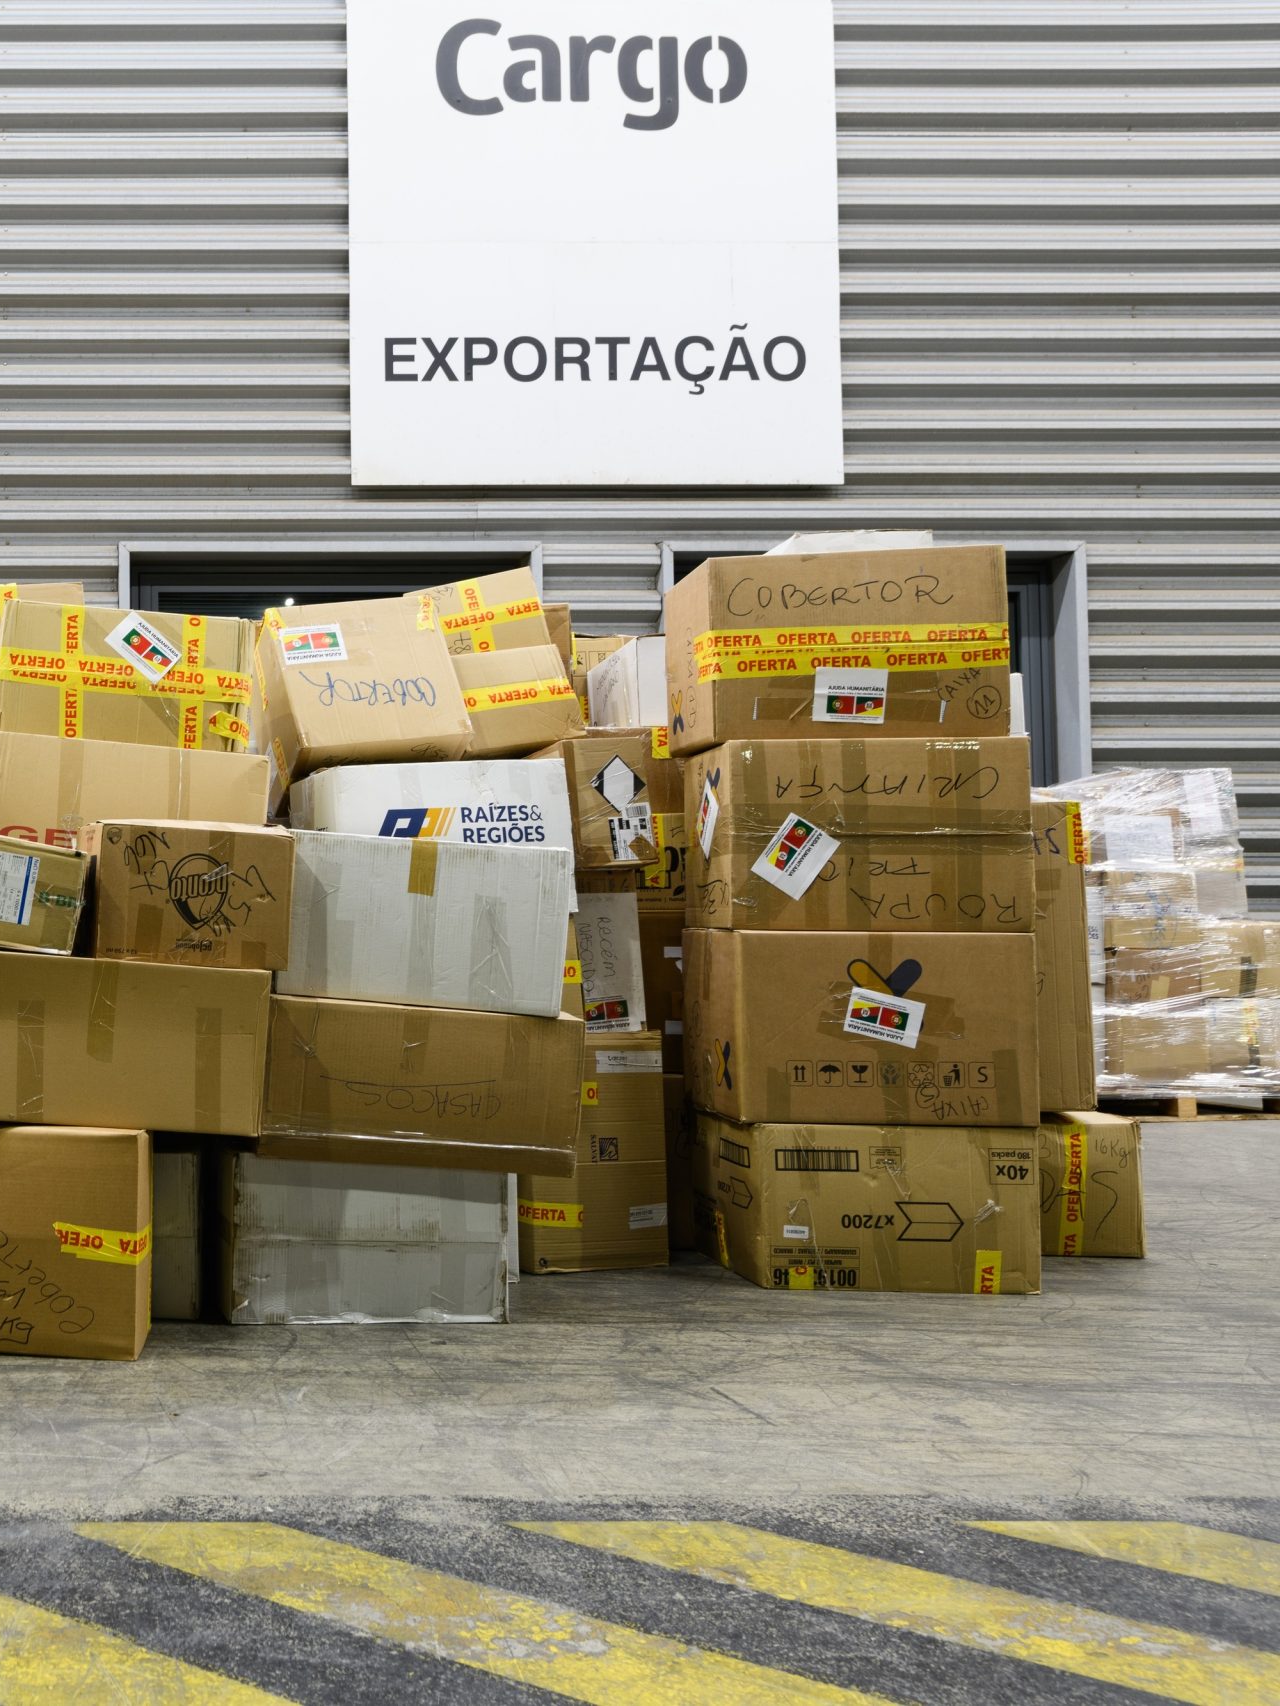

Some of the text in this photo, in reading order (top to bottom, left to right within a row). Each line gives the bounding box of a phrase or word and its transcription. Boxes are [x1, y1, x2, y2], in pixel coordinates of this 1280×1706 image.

[435, 18, 748, 131] Cargo
[383, 323, 807, 395] EXPORTAÇÃO
[727, 574, 954, 617] COBERTOR
[444, 610, 495, 631] OFERTA
[66, 614, 79, 655] ERTA
[707, 629, 988, 648] OFERTA OFERTA OFERTA OFERTA
[9, 653, 66, 670] OFERTA
[78, 659, 135, 677] OFERTA
[736, 658, 797, 673] OFERTA
[810, 654, 871, 670] OFERTA
[886, 651, 948, 666] OFERTA
[487, 685, 539, 705] OFERTA
[463, 823, 545, 843] REGIÕES
[849, 887, 1023, 924] ROUPA
[995, 1164, 1029, 1181] 40x
[841, 1214, 895, 1229] x7200
